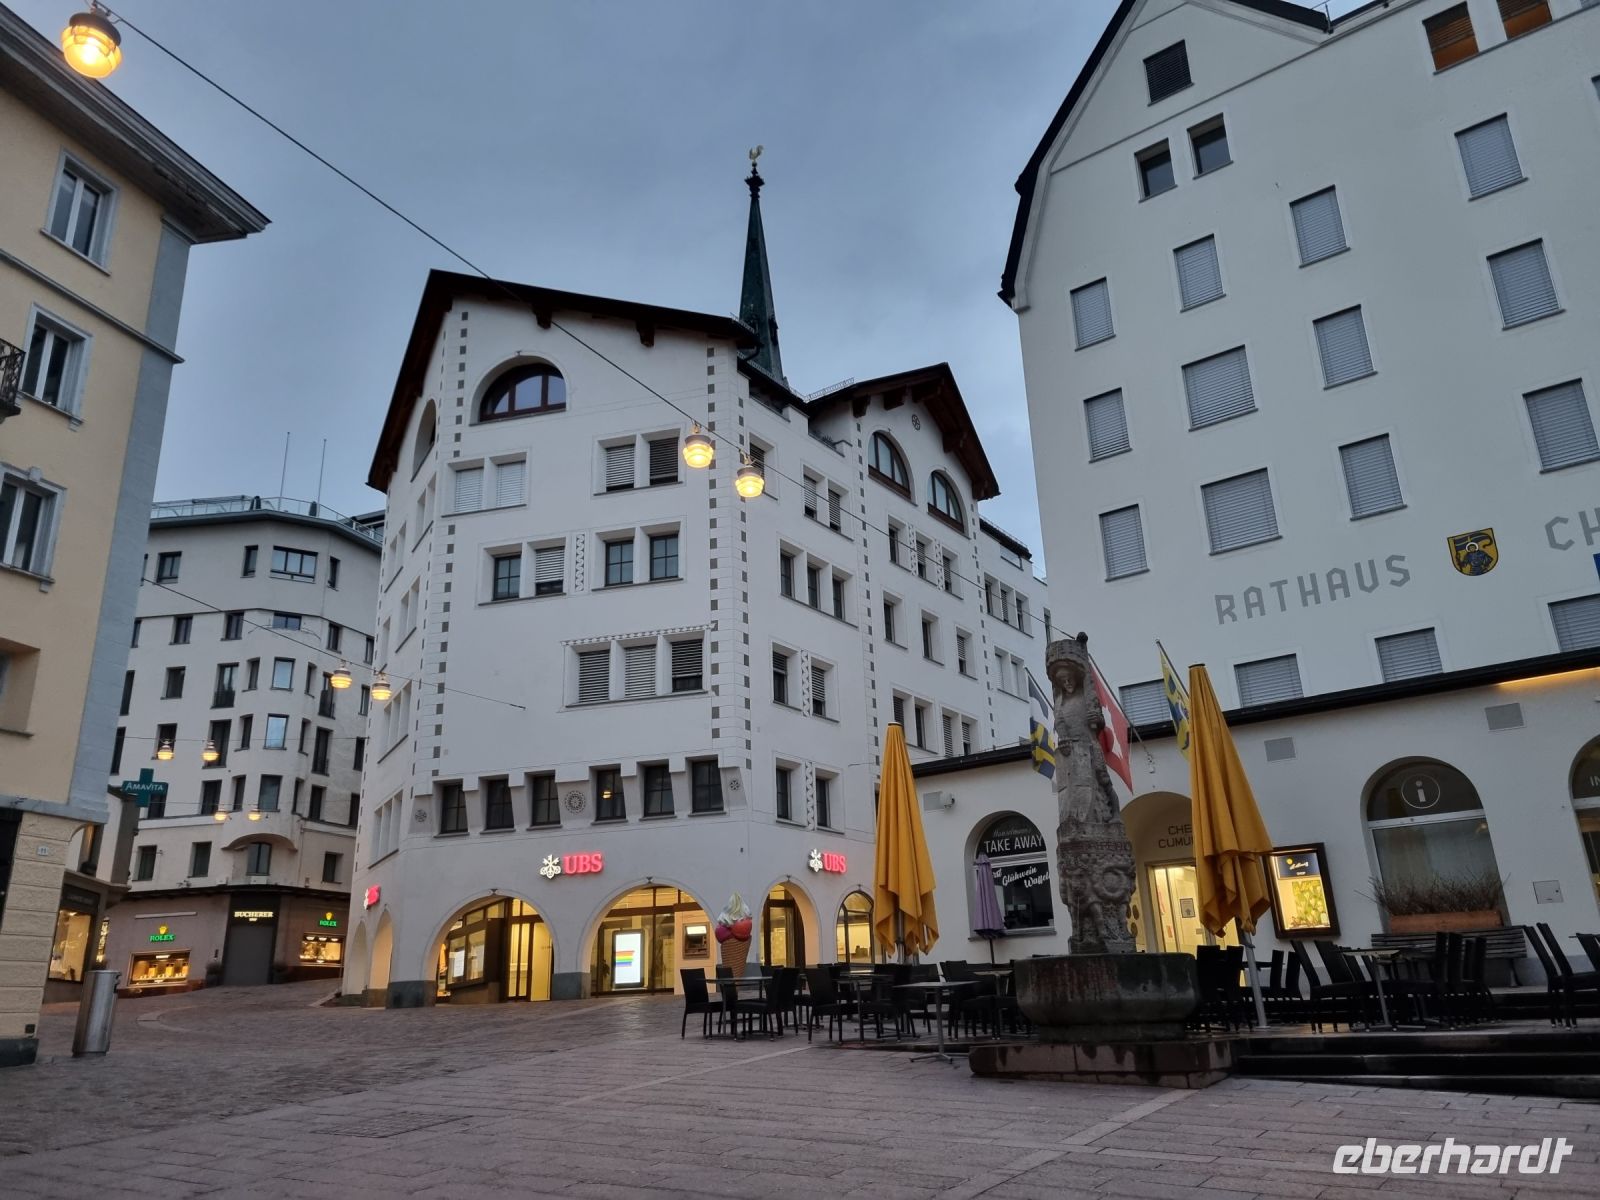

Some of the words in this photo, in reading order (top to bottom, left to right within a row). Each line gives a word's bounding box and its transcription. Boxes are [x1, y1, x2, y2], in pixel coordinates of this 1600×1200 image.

[1214, 554, 1411, 625] RATHAUS
[984, 838, 1011, 853] TAKE
[1014, 833, 1043, 850] AWAY
[1158, 836, 1193, 848] CUMU
[563, 854, 603, 874] UBS
[823, 853, 846, 873] UBS
[149, 934, 175, 942] ROLEX
